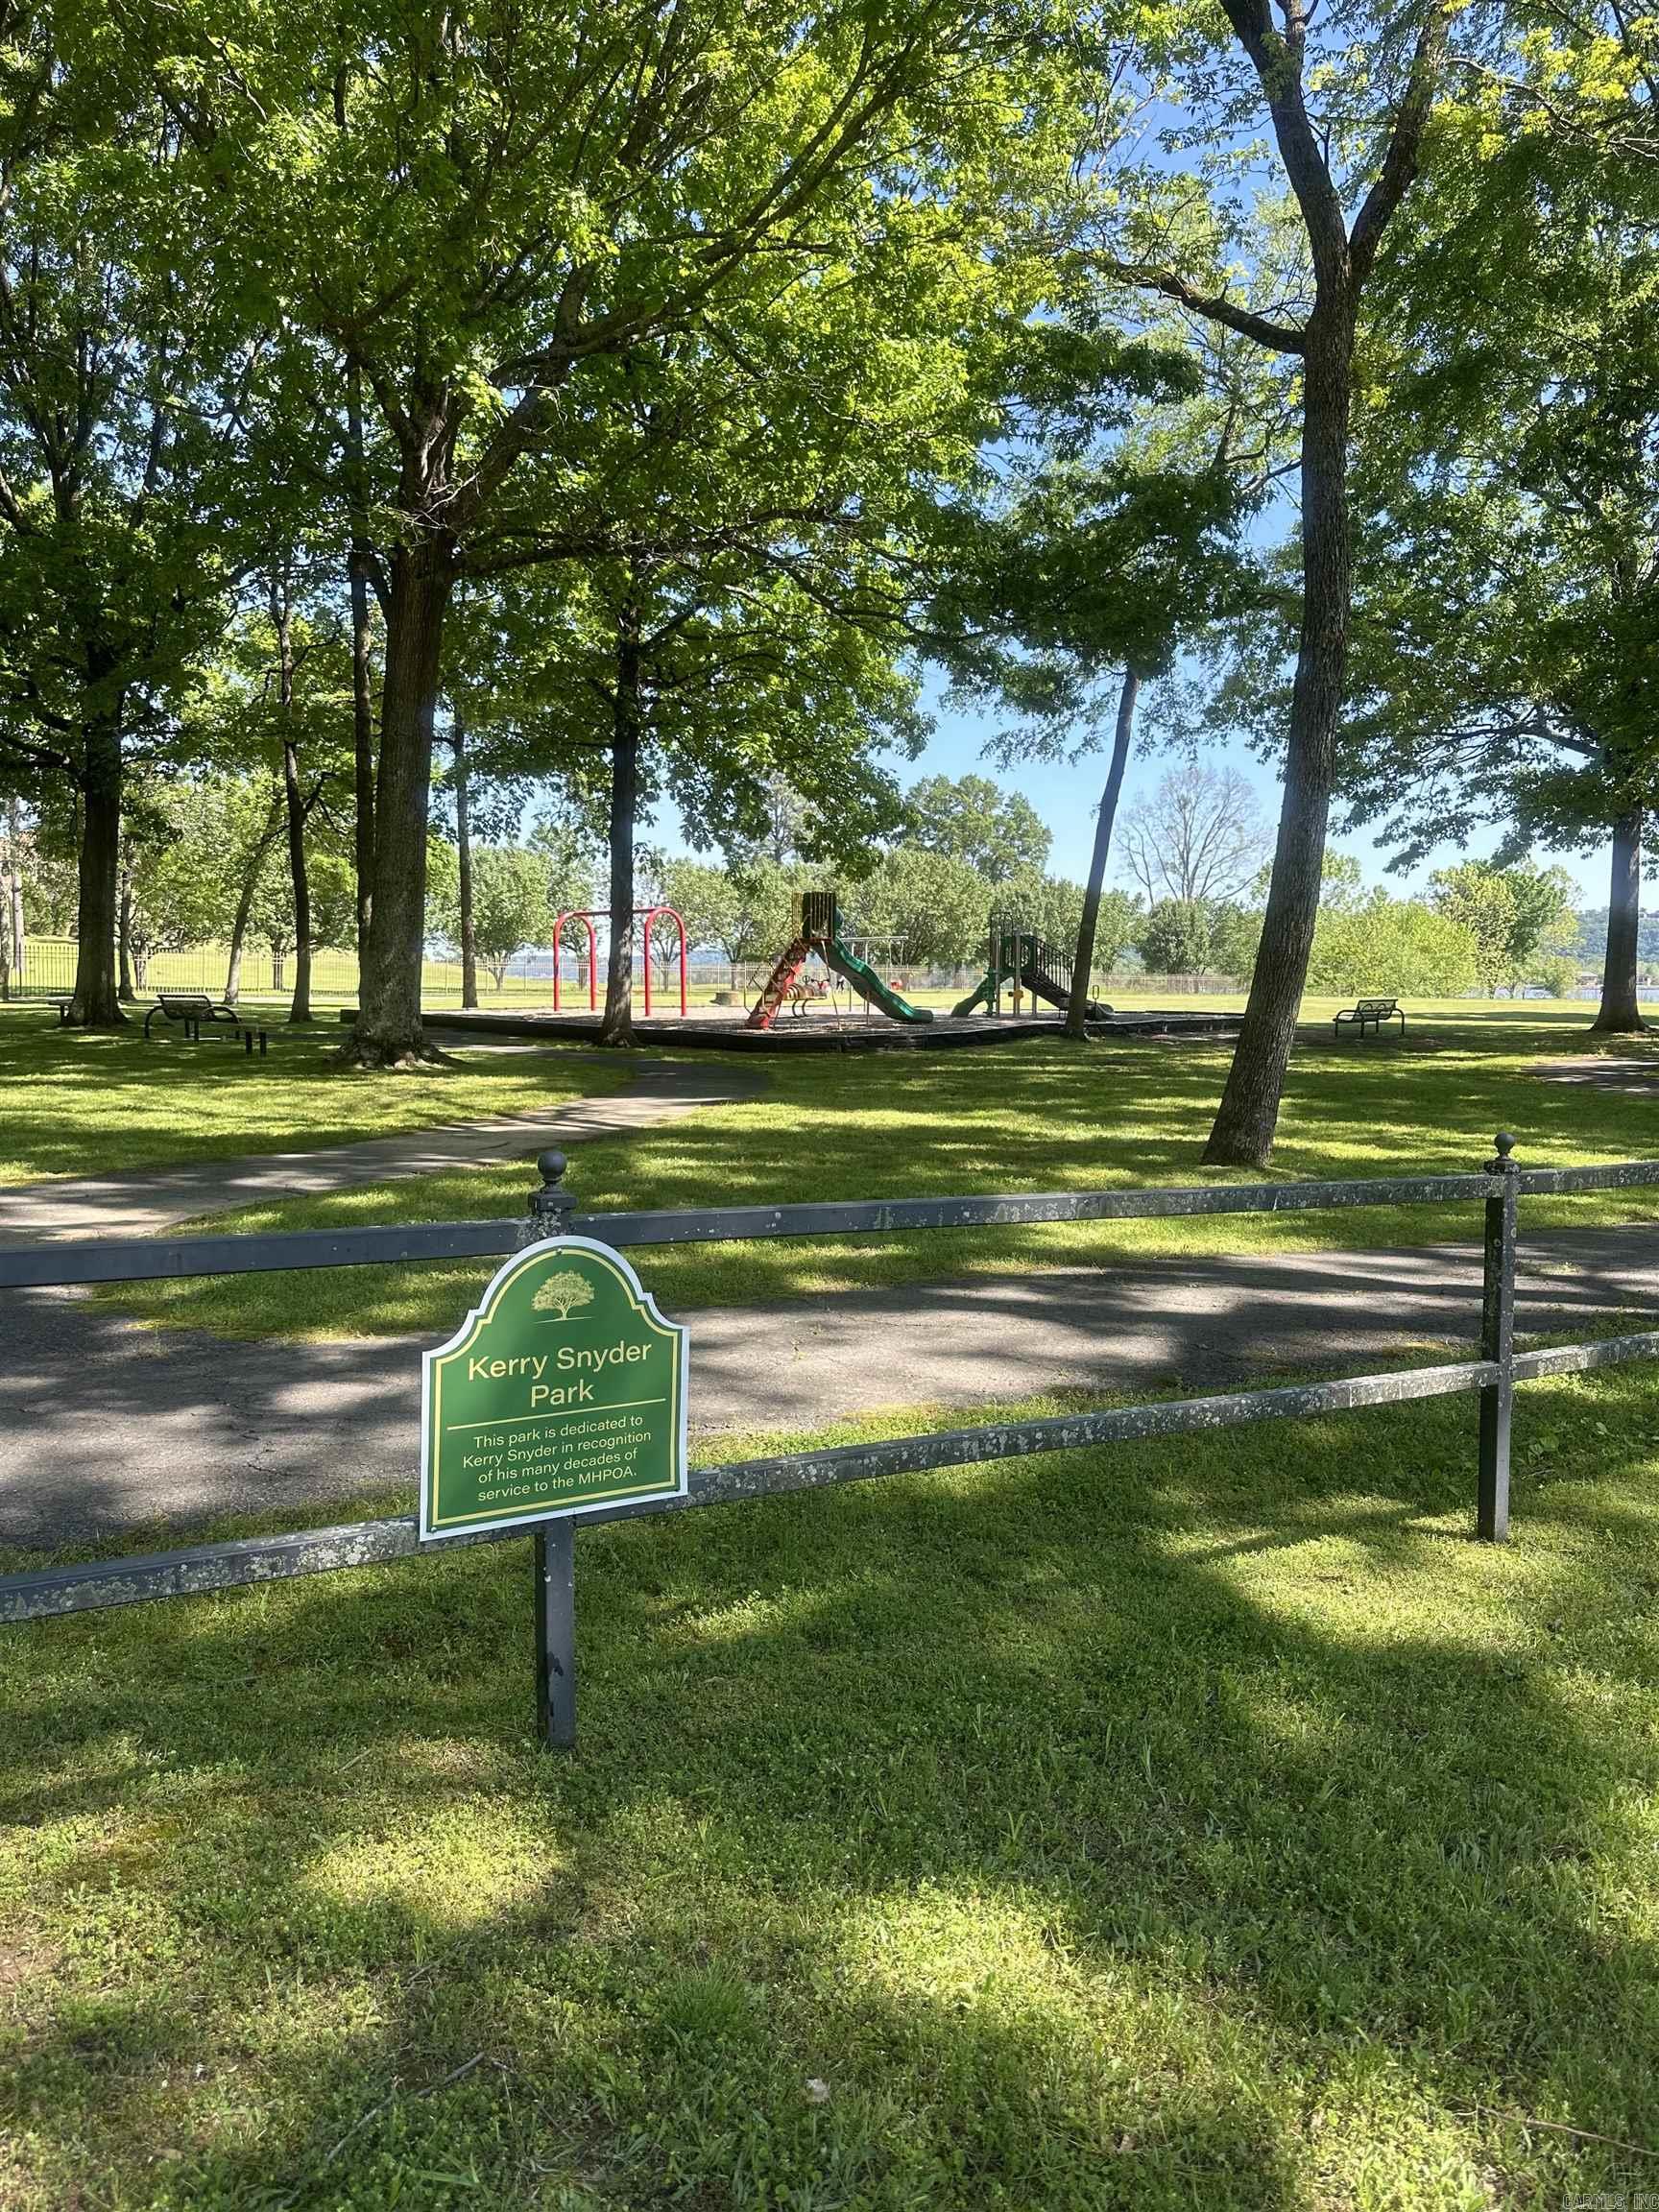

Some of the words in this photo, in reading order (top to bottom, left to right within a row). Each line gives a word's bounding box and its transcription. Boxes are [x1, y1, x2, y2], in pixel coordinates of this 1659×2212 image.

[469, 1355, 548, 1382] Kerry
[557, 1341, 653, 1373] Snyder
[531, 1380, 595, 1408] Park
[474, 1433, 505, 1449] This
[509, 1428, 541, 1447] park
[545, 1427, 557, 1438] is
[561, 1417, 627, 1435] dedicated
[631, 1415, 644, 1428] to
[463, 1453, 504, 1471] Kerry
[508, 1445, 558, 1463] Snyder
[562, 1441, 574, 1454] in
[578, 1431, 652, 1453] recognition
[478, 1471, 494, 1485] of
[497, 1467, 518, 1481] his
[522, 1463, 561, 1479] many
[564, 1453, 621, 1471] decades
[625, 1448, 638, 1460] of
[478, 1484, 531, 1503] service
[535, 1480, 549, 1492] to
[553, 1476, 574, 1489] the
[579, 1467, 637, 1485] MHPOA.
